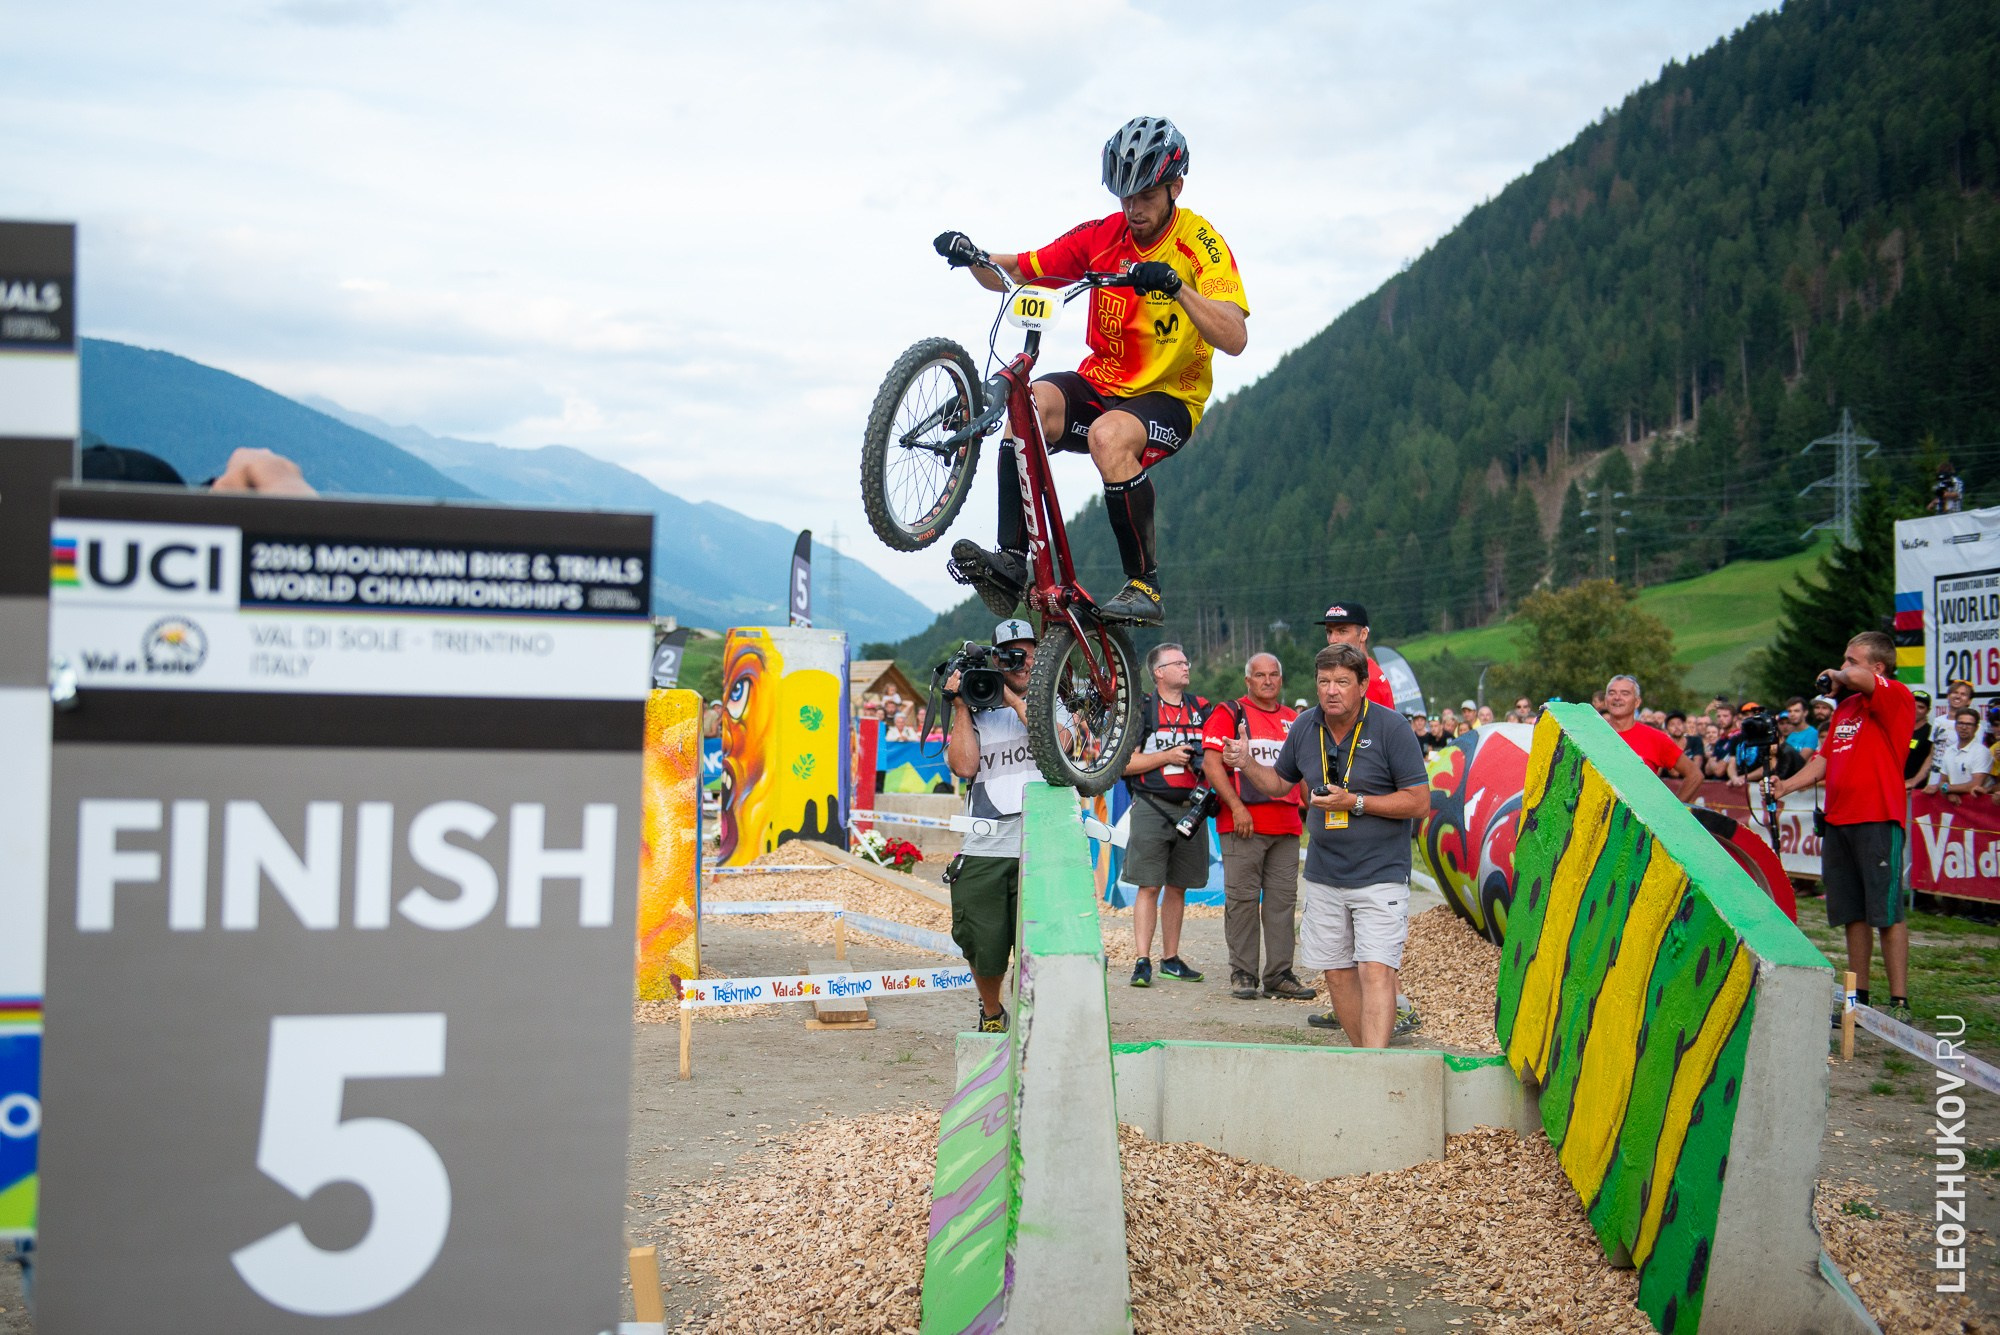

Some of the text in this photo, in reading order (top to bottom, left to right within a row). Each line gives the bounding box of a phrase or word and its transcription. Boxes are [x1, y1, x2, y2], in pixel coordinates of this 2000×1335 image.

[1020, 298, 1046, 318] 101
[88, 540, 221, 592] UCI
[251, 543, 644, 585] 2016 MOUNTAIN BIKE & TRIALS
[250, 571, 357, 602] WORLD
[358, 575, 584, 611] CHAMPIONSHIPS
[796, 567, 808, 611] 5
[1941, 577, 1999, 593] UCI MOUNTAIN BIKE
[1940, 594, 2000, 624] WORLD
[250, 624, 293, 649] VAL
[303, 625, 331, 649] DI
[337, 625, 400, 652] SOLE
[431, 629, 556, 656] TRENTINO
[1943, 628, 1999, 643] CHAMPIONSHIPS
[250, 653, 313, 677] ITALY
[658, 649, 676, 674] 2
[1946, 648, 2000, 687] 2016
[77, 799, 618, 930] FINISH
[1916, 812, 1976, 883] Val
[713, 985, 762, 1002] TRENTINO
[772, 981, 788, 998] Val
[789, 987, 796, 996] di
[797, 981, 821, 996] Sole
[828, 979, 872, 997] TRENTINO
[882, 975, 896, 991] Val
[904, 975, 926, 990] Sole
[932, 972, 973, 989] TRENTINO
[230, 1013, 452, 1317] 5
